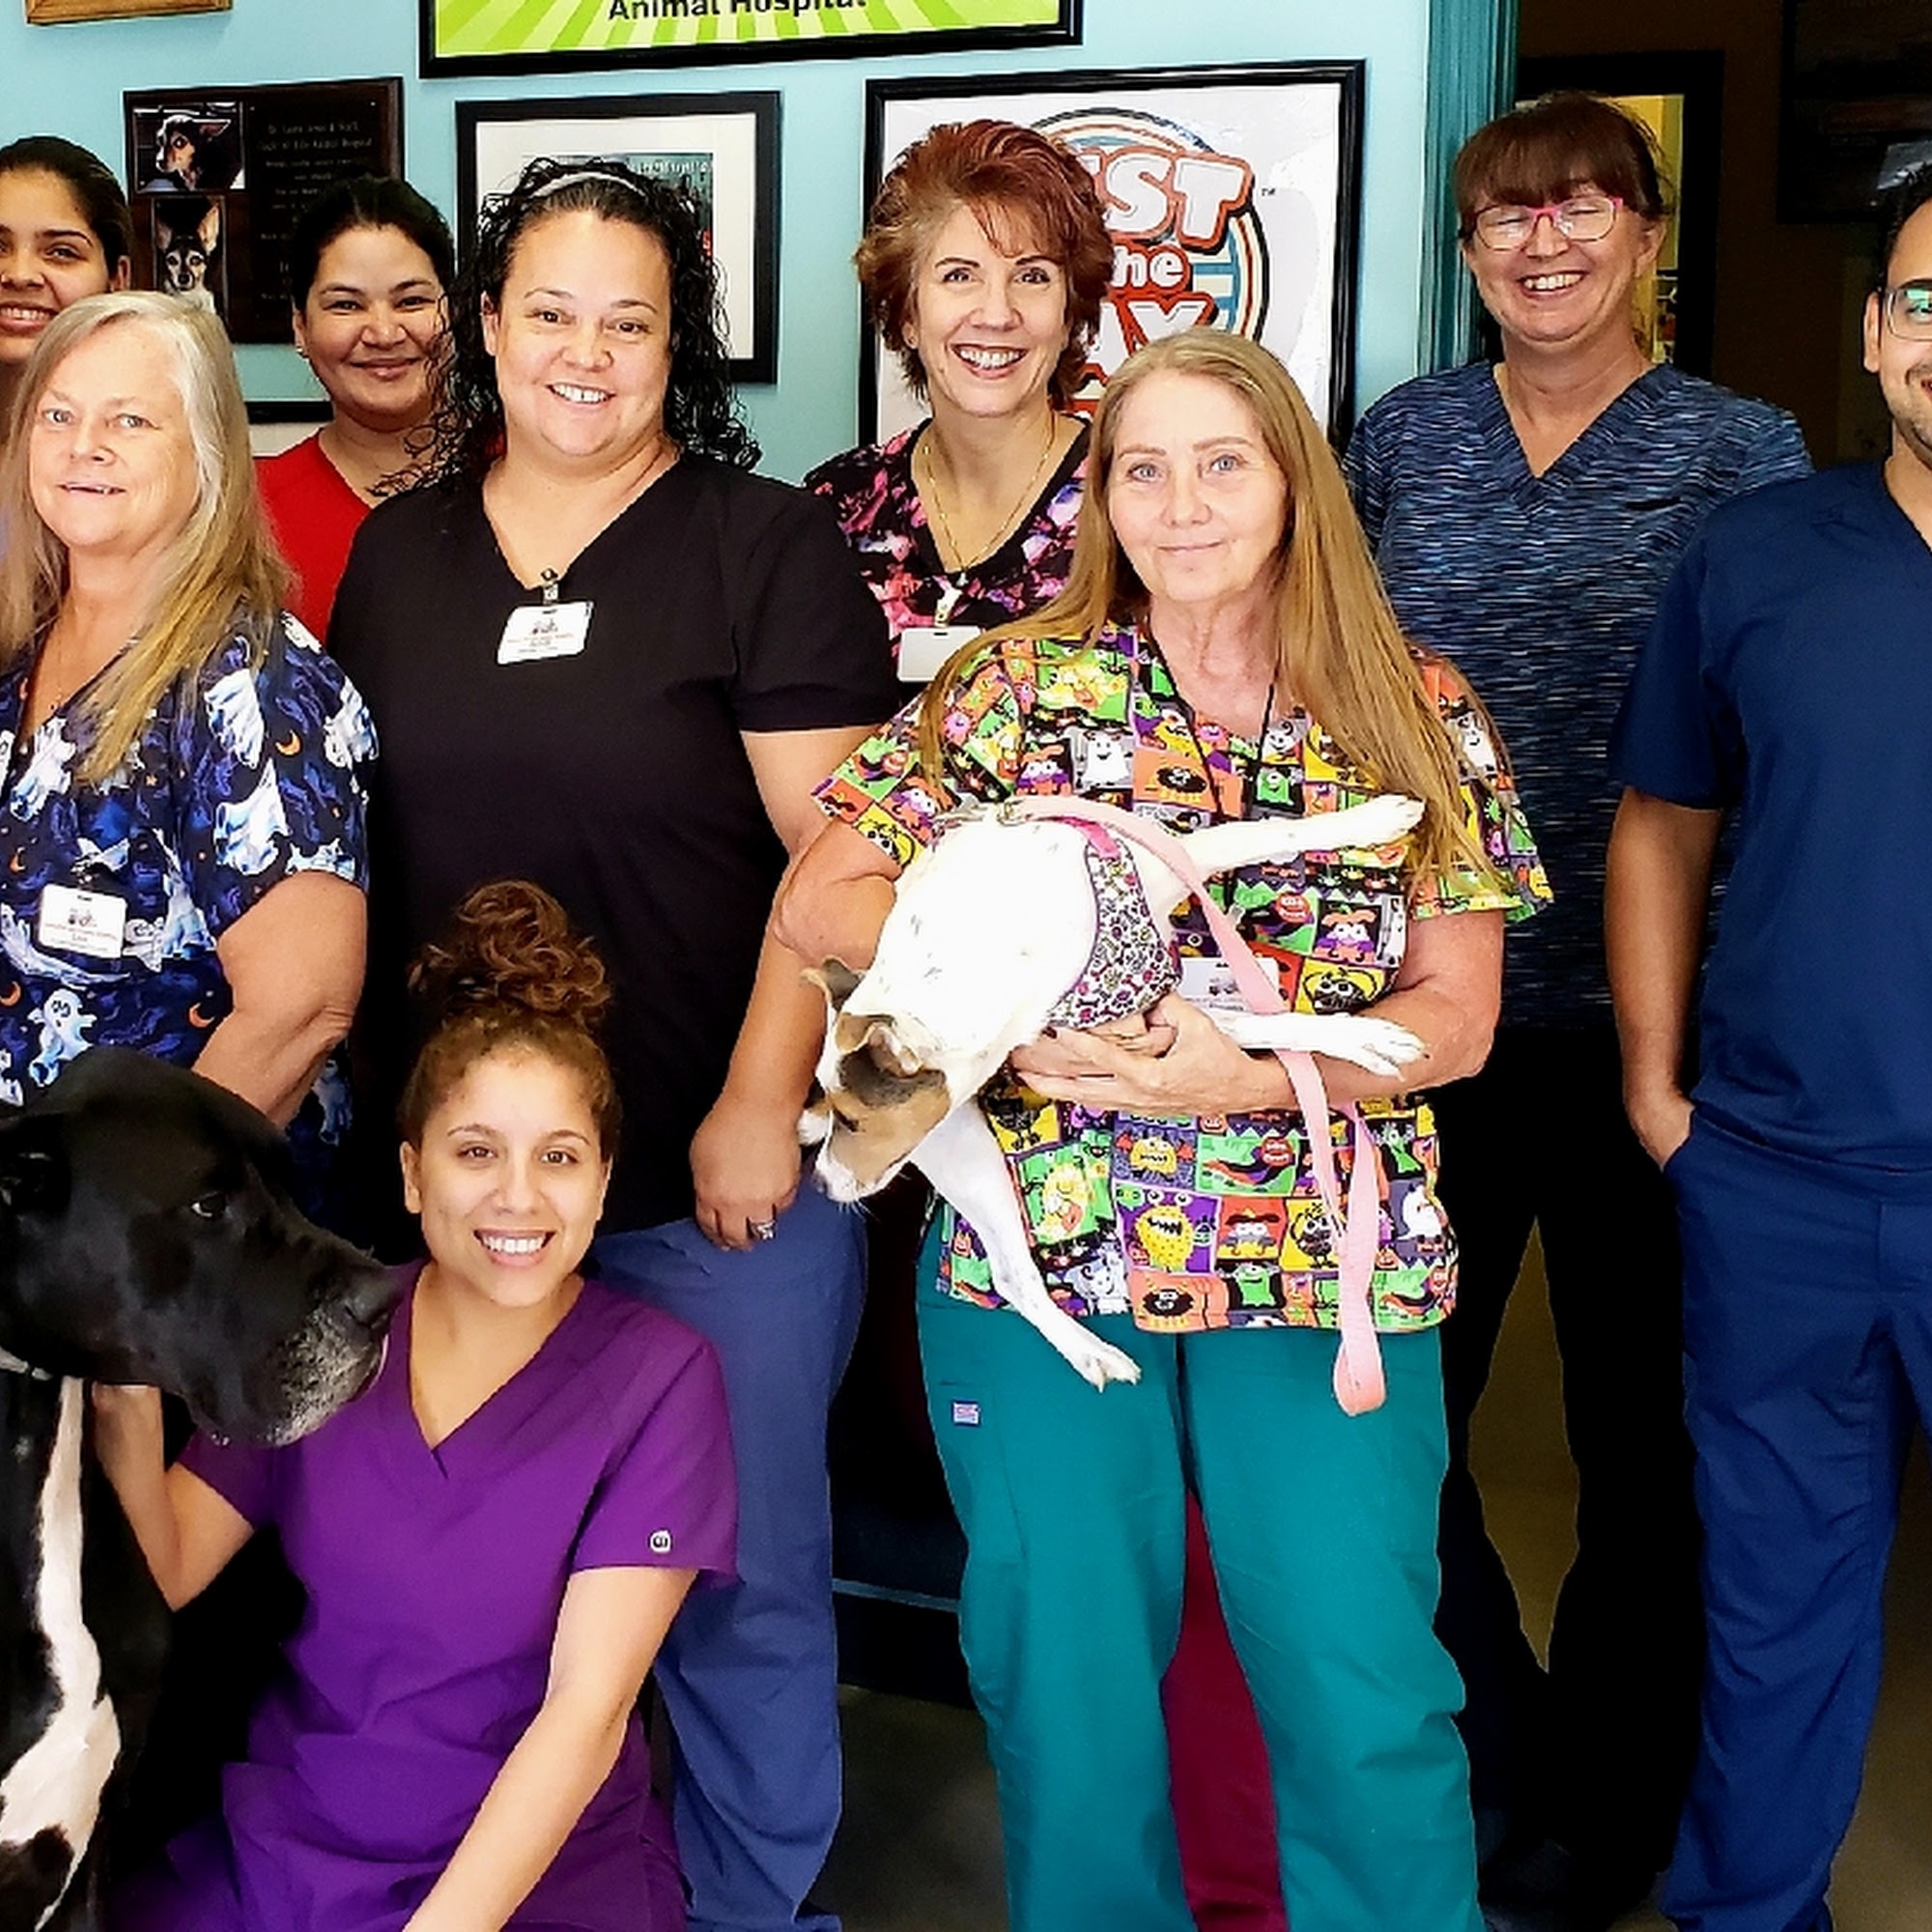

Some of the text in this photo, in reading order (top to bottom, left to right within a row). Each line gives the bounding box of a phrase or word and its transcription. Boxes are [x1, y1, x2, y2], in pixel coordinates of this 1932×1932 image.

[608, 0, 721, 19] Animal
[1075, 152, 1247, 242] ST
[1110, 244, 1185, 288] he
[1076, 298, 1209, 378] AY
